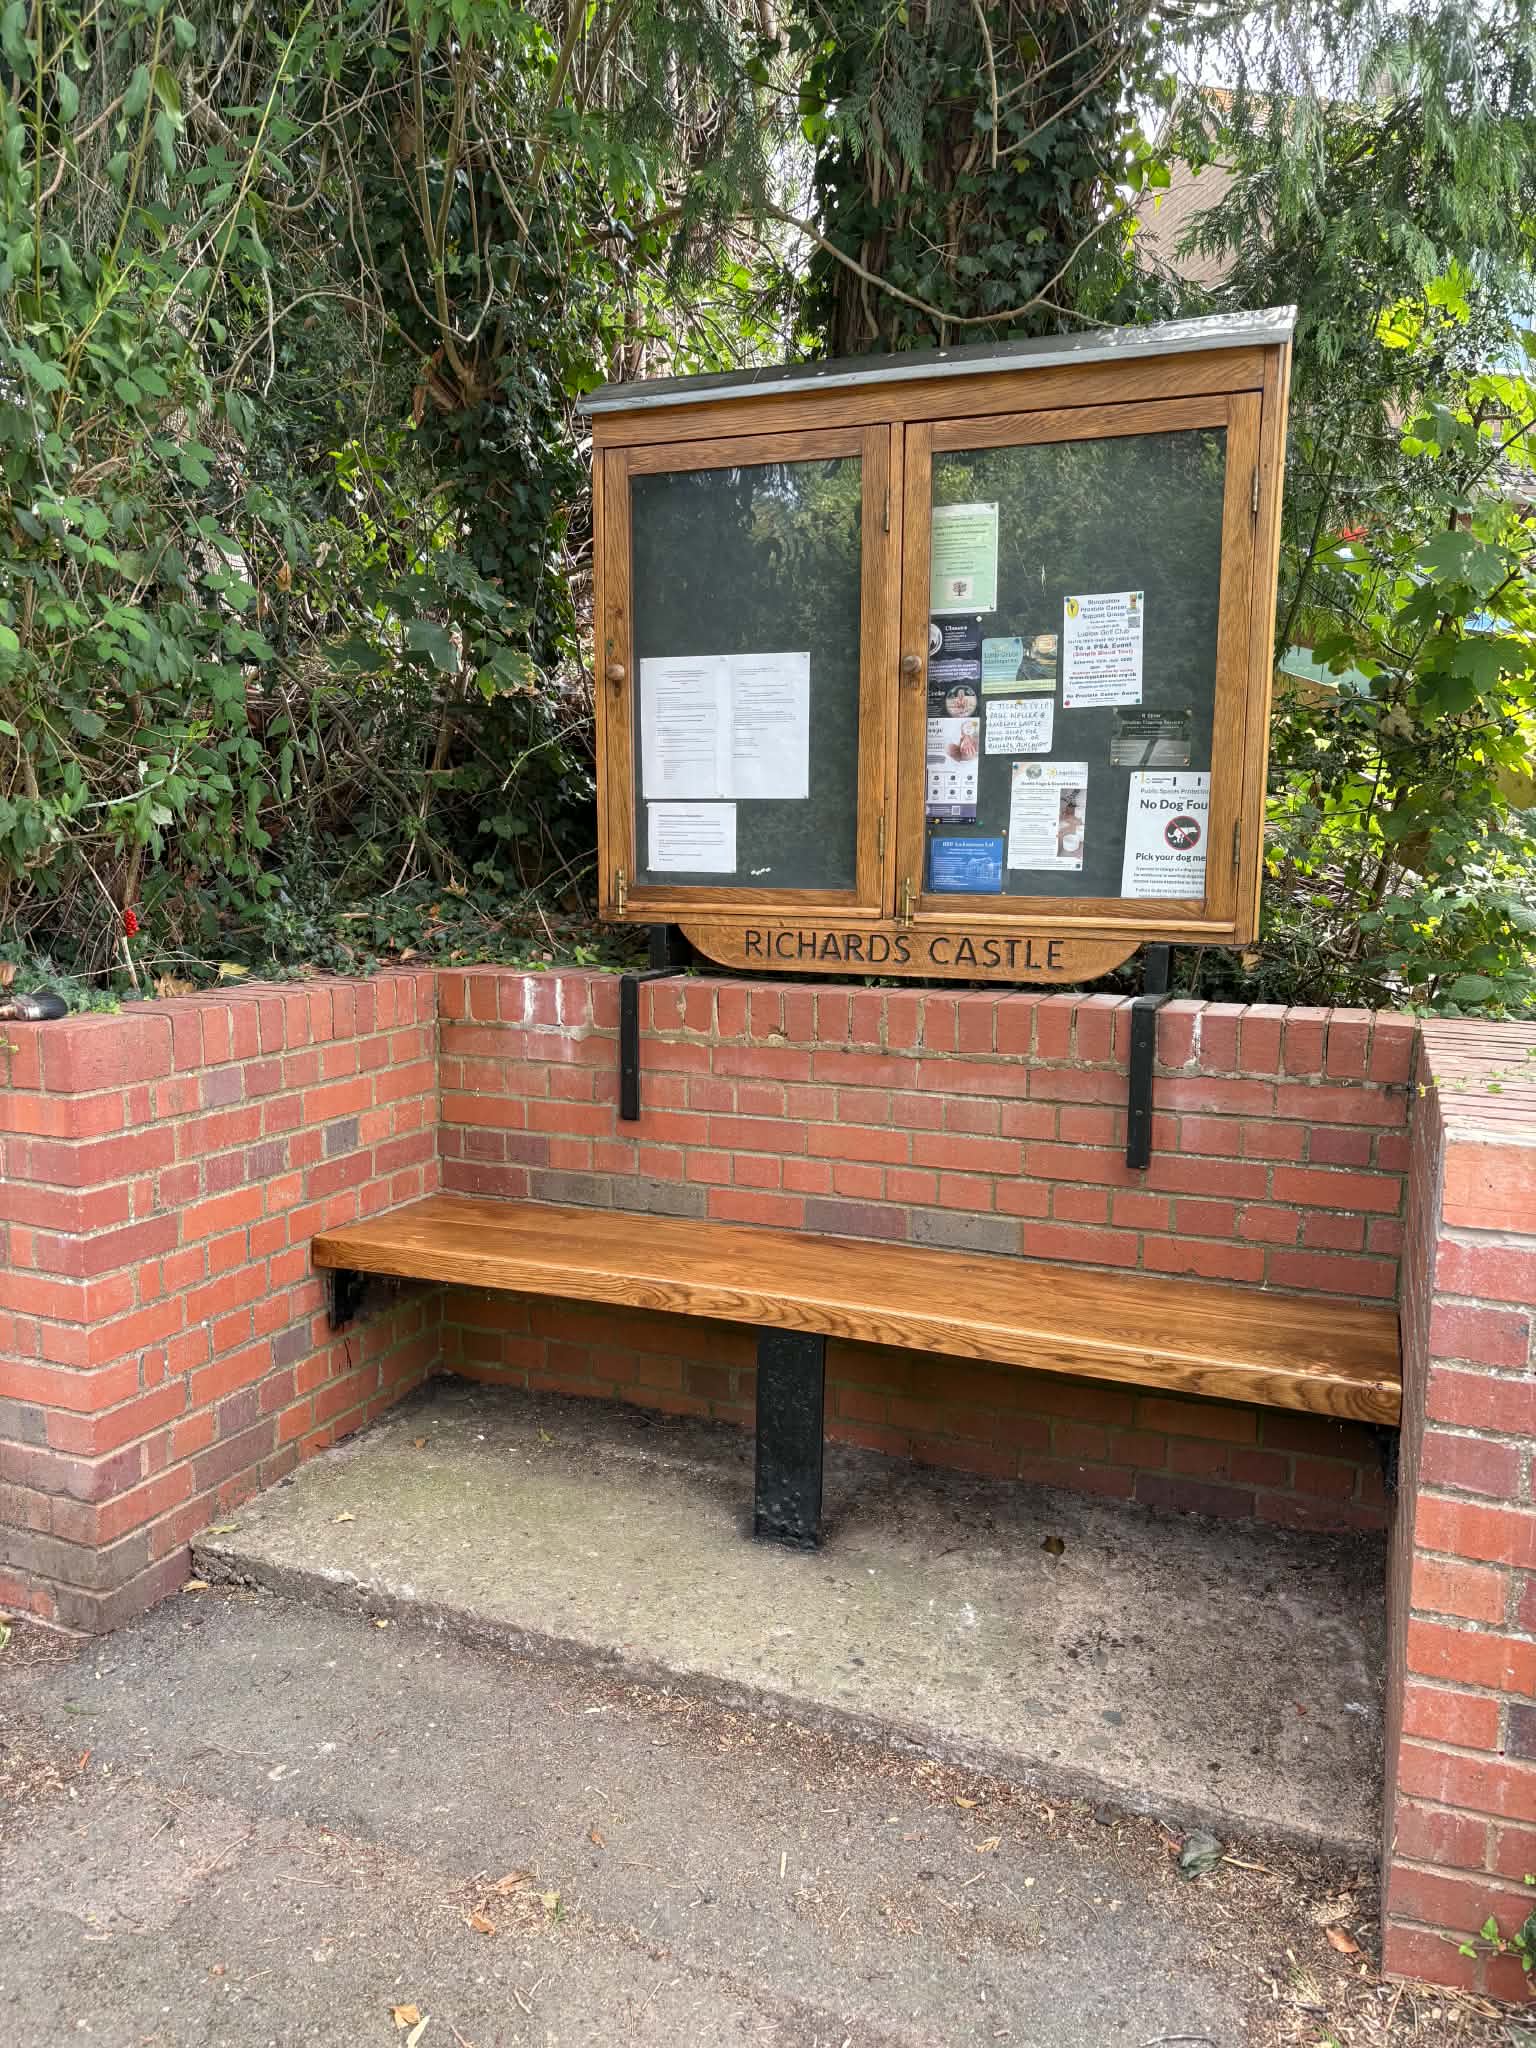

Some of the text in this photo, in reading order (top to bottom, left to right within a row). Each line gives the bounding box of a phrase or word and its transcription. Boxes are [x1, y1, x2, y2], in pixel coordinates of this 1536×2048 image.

[1140, 800, 1208, 811] No Dog Fou
[1176, 854, 1191, 862] dog
[745, 929, 1065, 969] RICHARDS CASTLE
